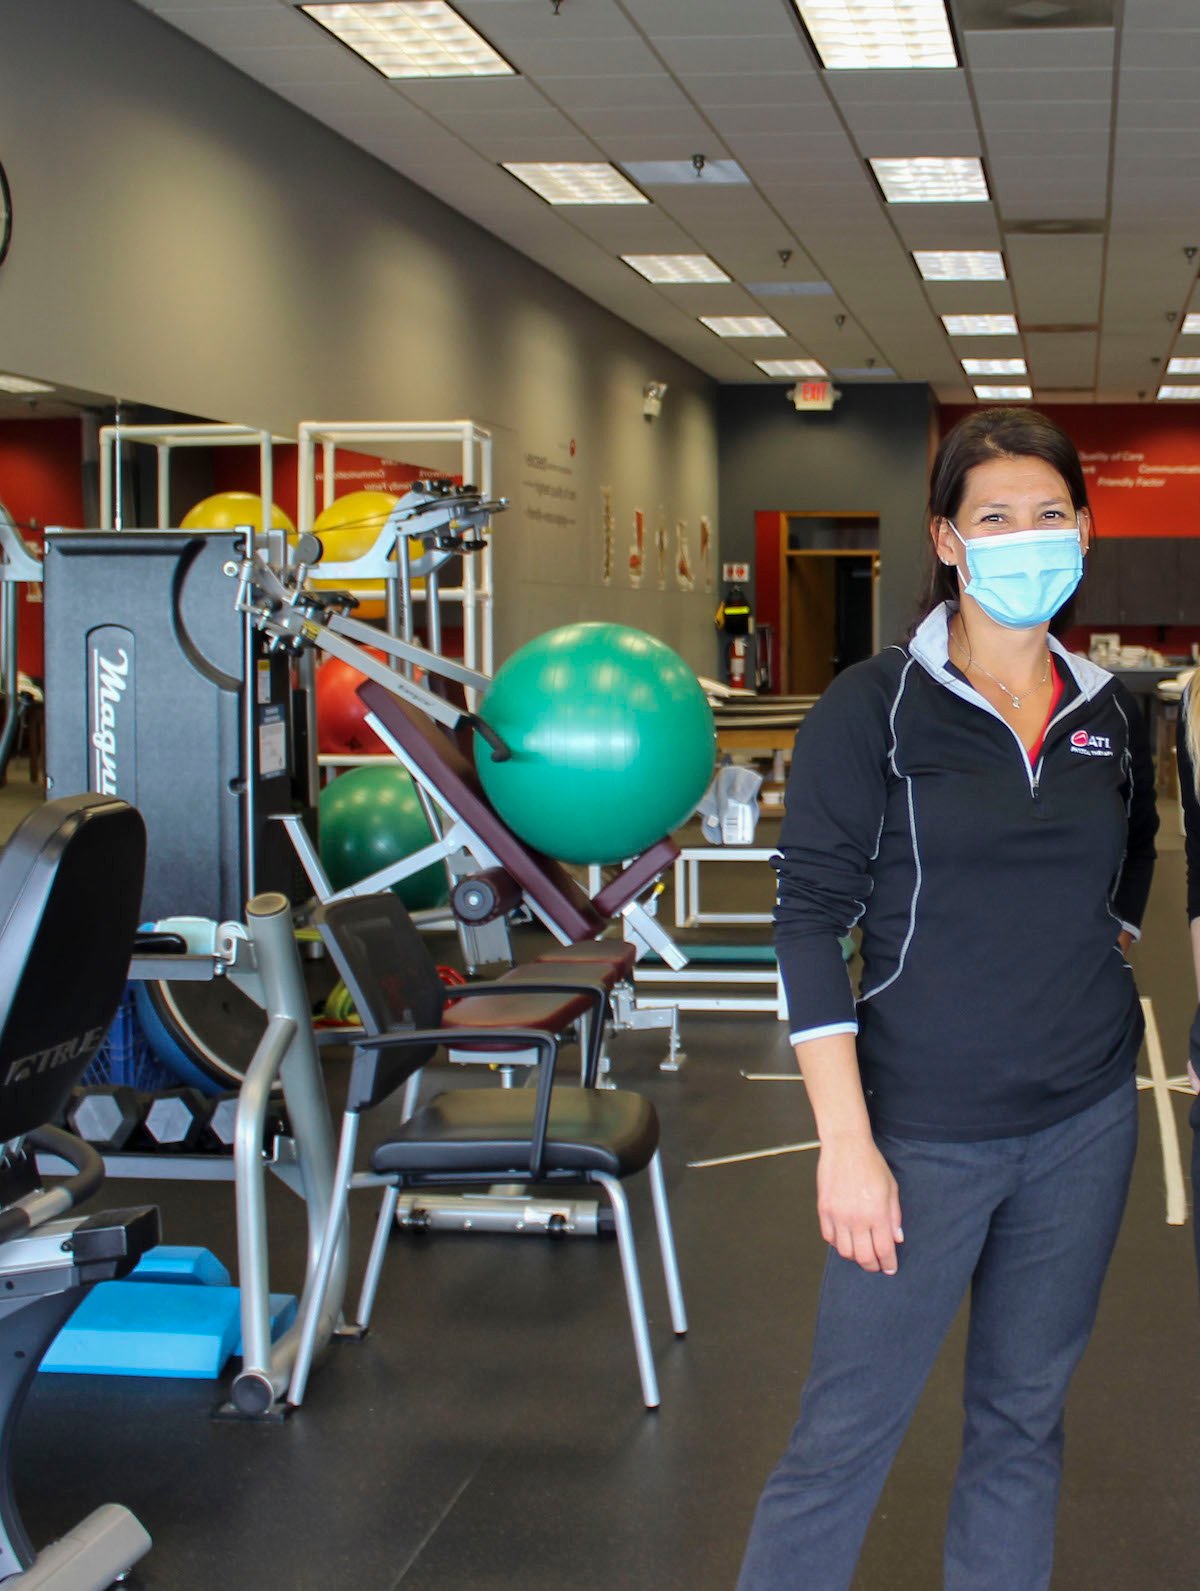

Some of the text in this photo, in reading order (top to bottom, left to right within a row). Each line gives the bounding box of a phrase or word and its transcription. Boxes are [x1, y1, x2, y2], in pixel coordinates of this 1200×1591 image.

[801, 383, 826, 401] EXIT
[1097, 477, 1167, 488] Friendly Factor
[92, 648, 129, 796] Magn
[1087, 736, 1111, 749] ATI
[36, 1026, 103, 1073] TRUE
